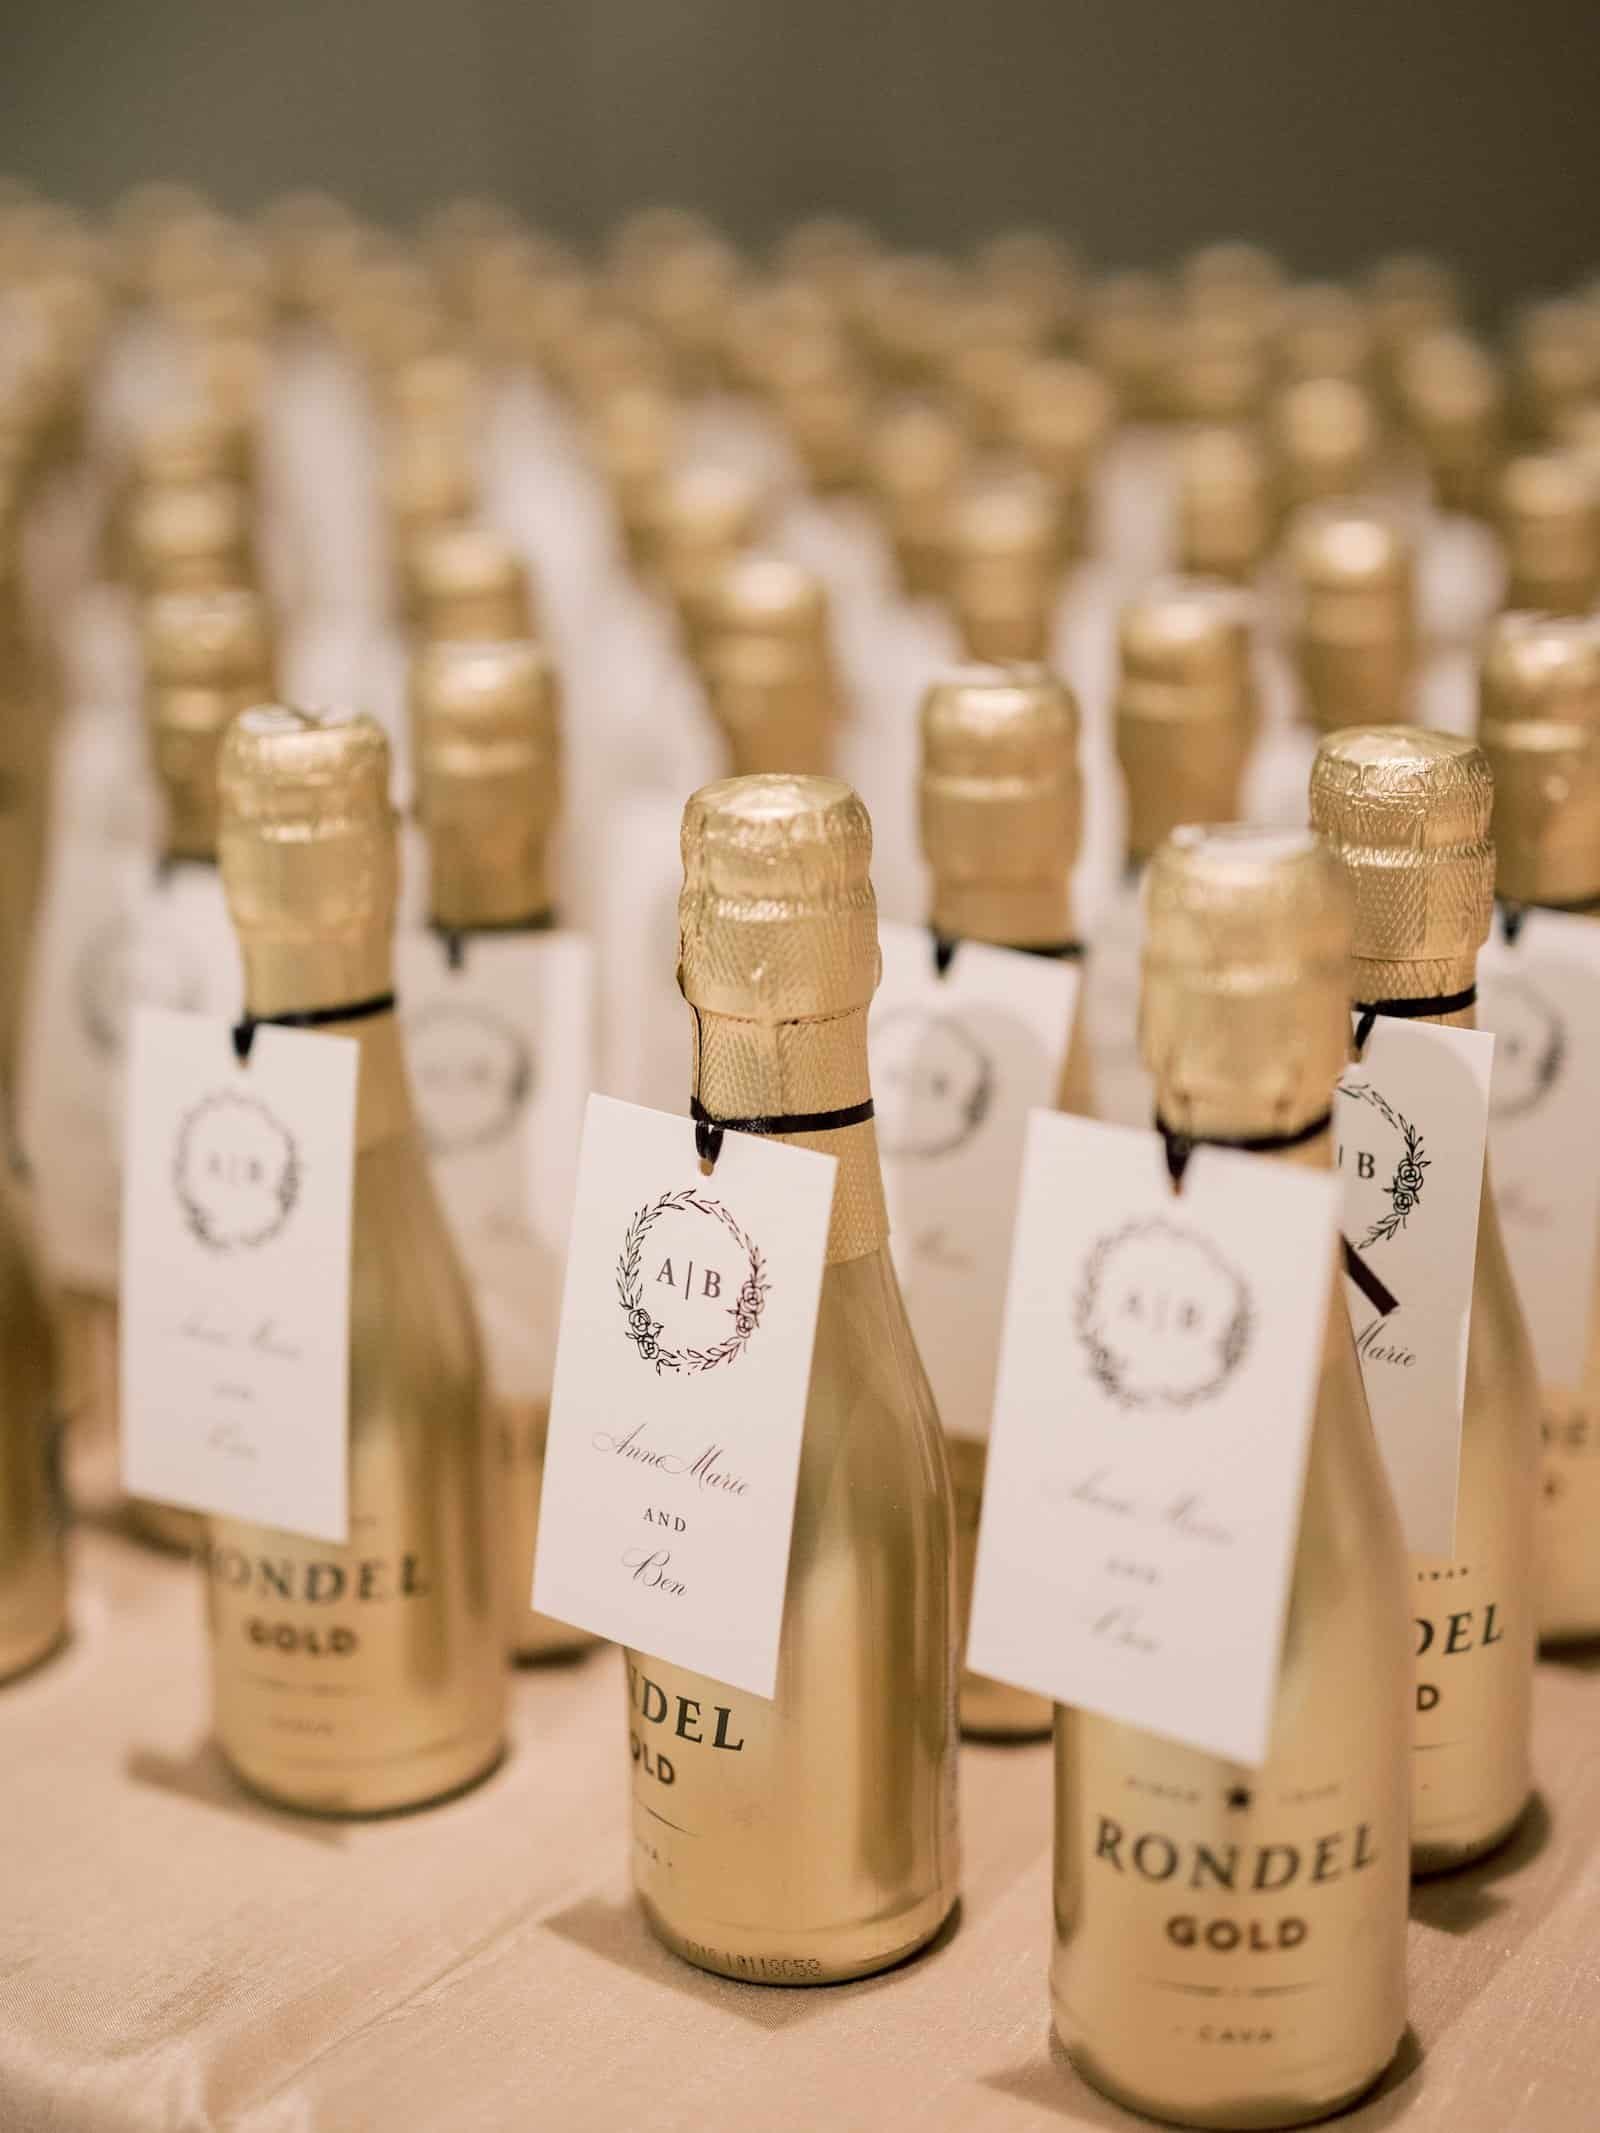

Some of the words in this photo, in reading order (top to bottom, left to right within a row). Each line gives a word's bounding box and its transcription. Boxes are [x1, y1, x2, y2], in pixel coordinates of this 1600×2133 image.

[643, 1507, 687, 1533] AND
[208, 1553, 428, 1606] ONDEL
[620, 1547, 688, 1597] Ben
[1094, 1813, 1378, 1893] RONDEL
[1165, 1914, 1309, 1952] GOLD
